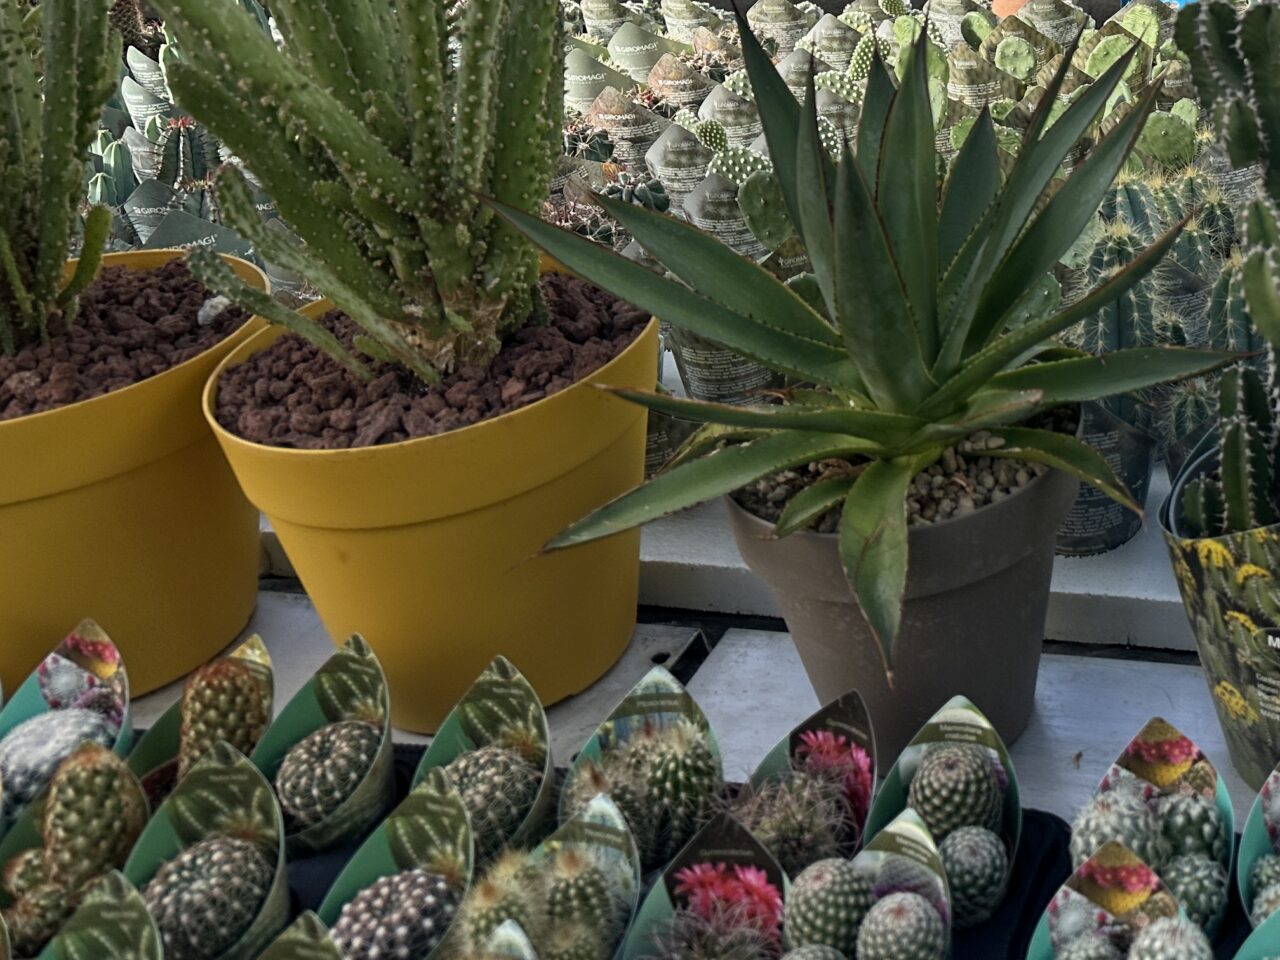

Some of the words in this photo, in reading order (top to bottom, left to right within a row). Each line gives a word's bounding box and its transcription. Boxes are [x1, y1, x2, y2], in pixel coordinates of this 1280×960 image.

[620, 42, 658, 53] GIROMAGI
[604, 113, 636, 121] GIROMAGI
[162, 233, 216, 251] IROMAGI
